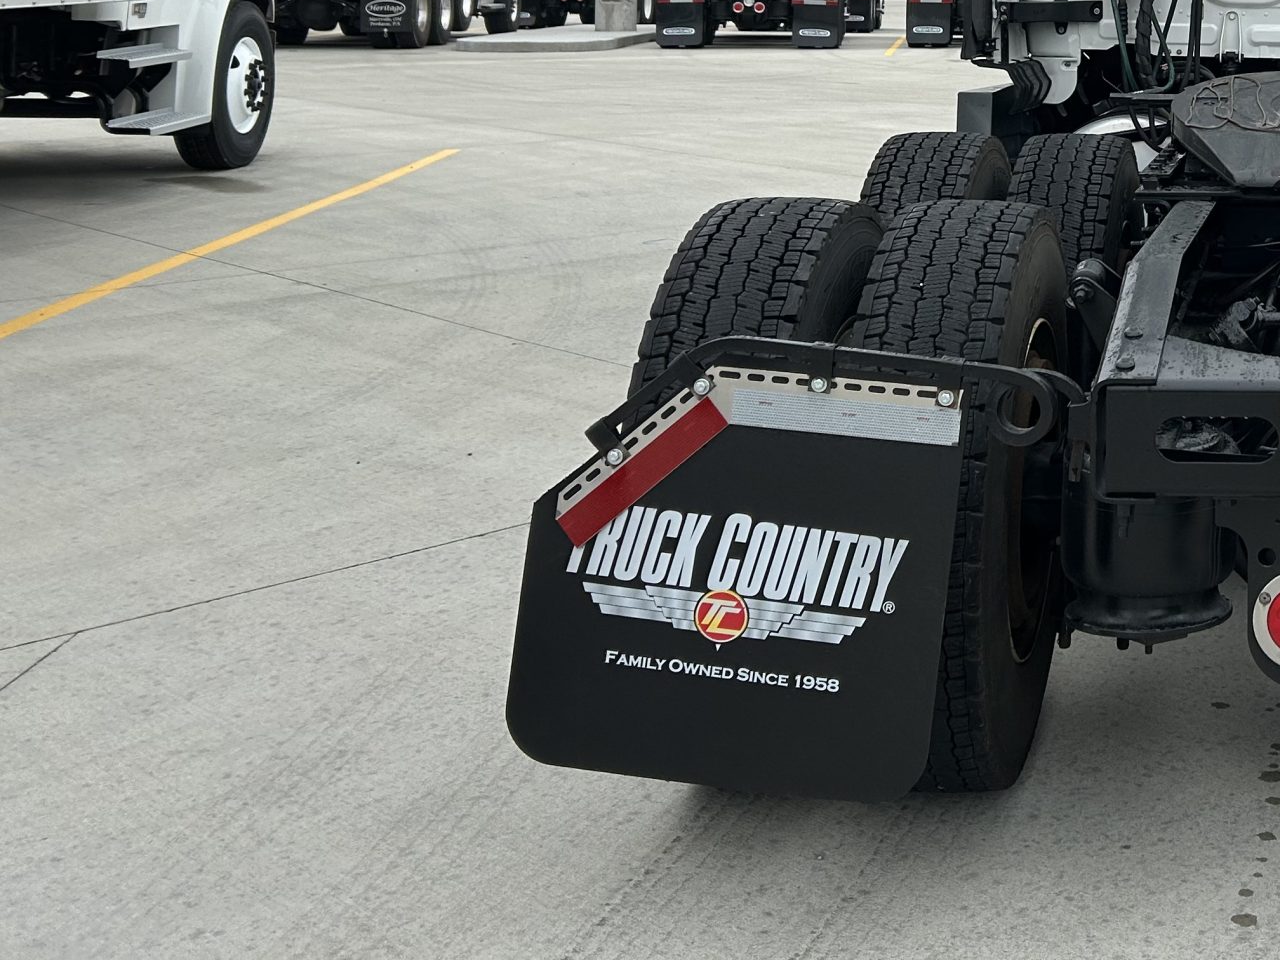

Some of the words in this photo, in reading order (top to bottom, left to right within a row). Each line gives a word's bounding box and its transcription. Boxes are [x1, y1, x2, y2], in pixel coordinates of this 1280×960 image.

[368, 4, 404, 14] Heritage
[700, 598, 742, 637] TC
[604, 649, 667, 671] FAMILY
[668, 658, 734, 680] OWNED
[736, 667, 789, 688] SINCE
[794, 674, 840, 693] 1958
